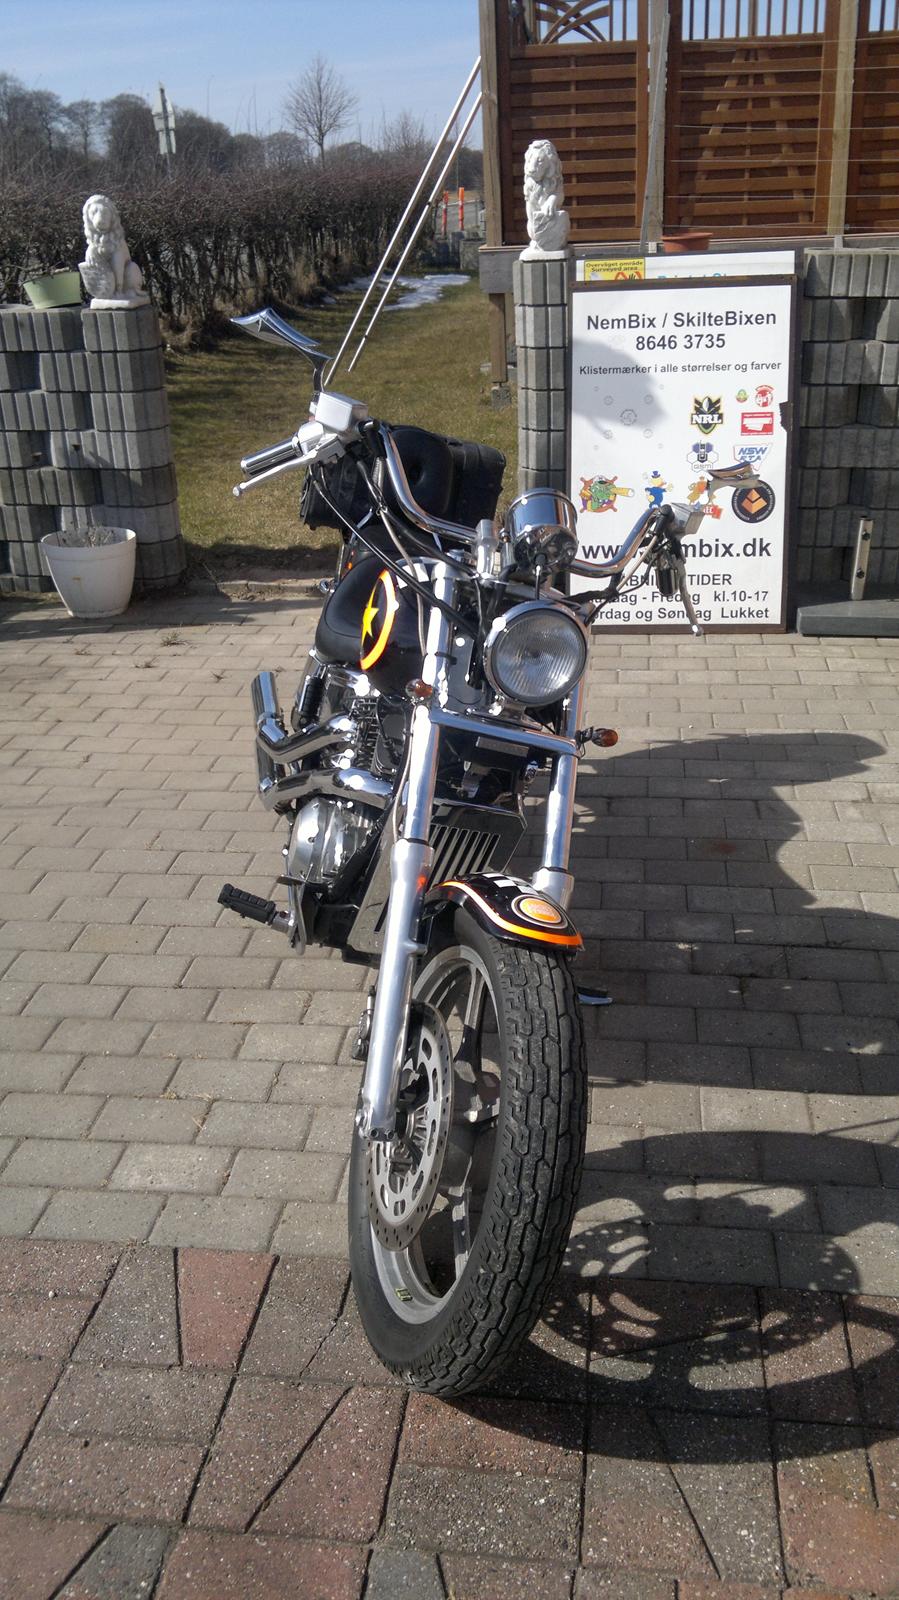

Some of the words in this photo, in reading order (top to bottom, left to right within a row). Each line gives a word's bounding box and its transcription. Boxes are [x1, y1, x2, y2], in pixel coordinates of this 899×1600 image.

[587, 314, 656, 330] NemBix
[662, 313, 668, 328] /
[673, 310, 776, 328] SkilteBixen
[636, 335, 678, 350] 8646
[684, 334, 726, 349] 3735
[580, 364, 652, 375] Klistermærker
[660, 364, 678, 372] alle
[682, 363, 731, 372] størrelser
[734, 364, 748, 373] og
[750, 362, 782, 370] farver
[692, 414, 722, 424] NRL
[738, 447, 768, 455] NSW
[635, 611, 652, 620] og
[721, 608, 769, 618] Lukket
